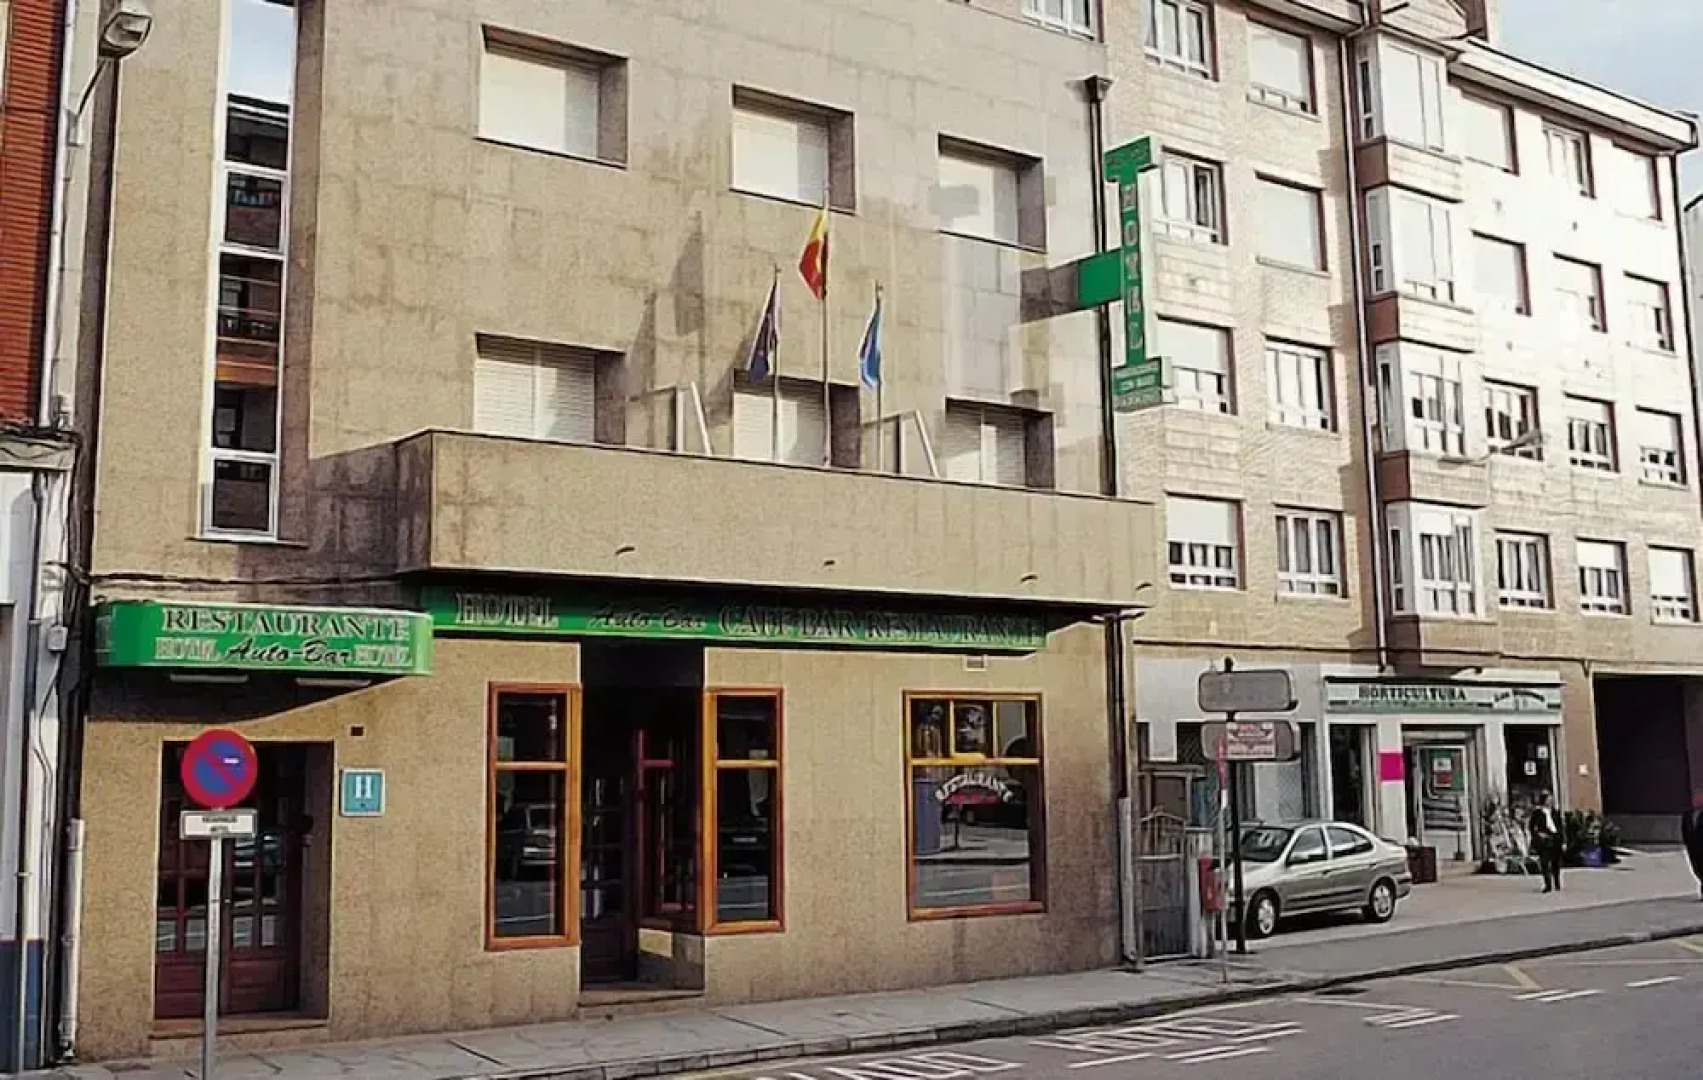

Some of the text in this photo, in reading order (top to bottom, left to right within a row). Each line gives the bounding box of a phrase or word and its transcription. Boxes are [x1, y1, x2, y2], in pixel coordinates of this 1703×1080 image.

[162, 607, 410, 641] RESTAURANTE
[455, 592, 559, 629] HOTEL
[864, 608, 1048, 647] RESTAURANTE
[223, 637, 350, 665] Auto-Bar
